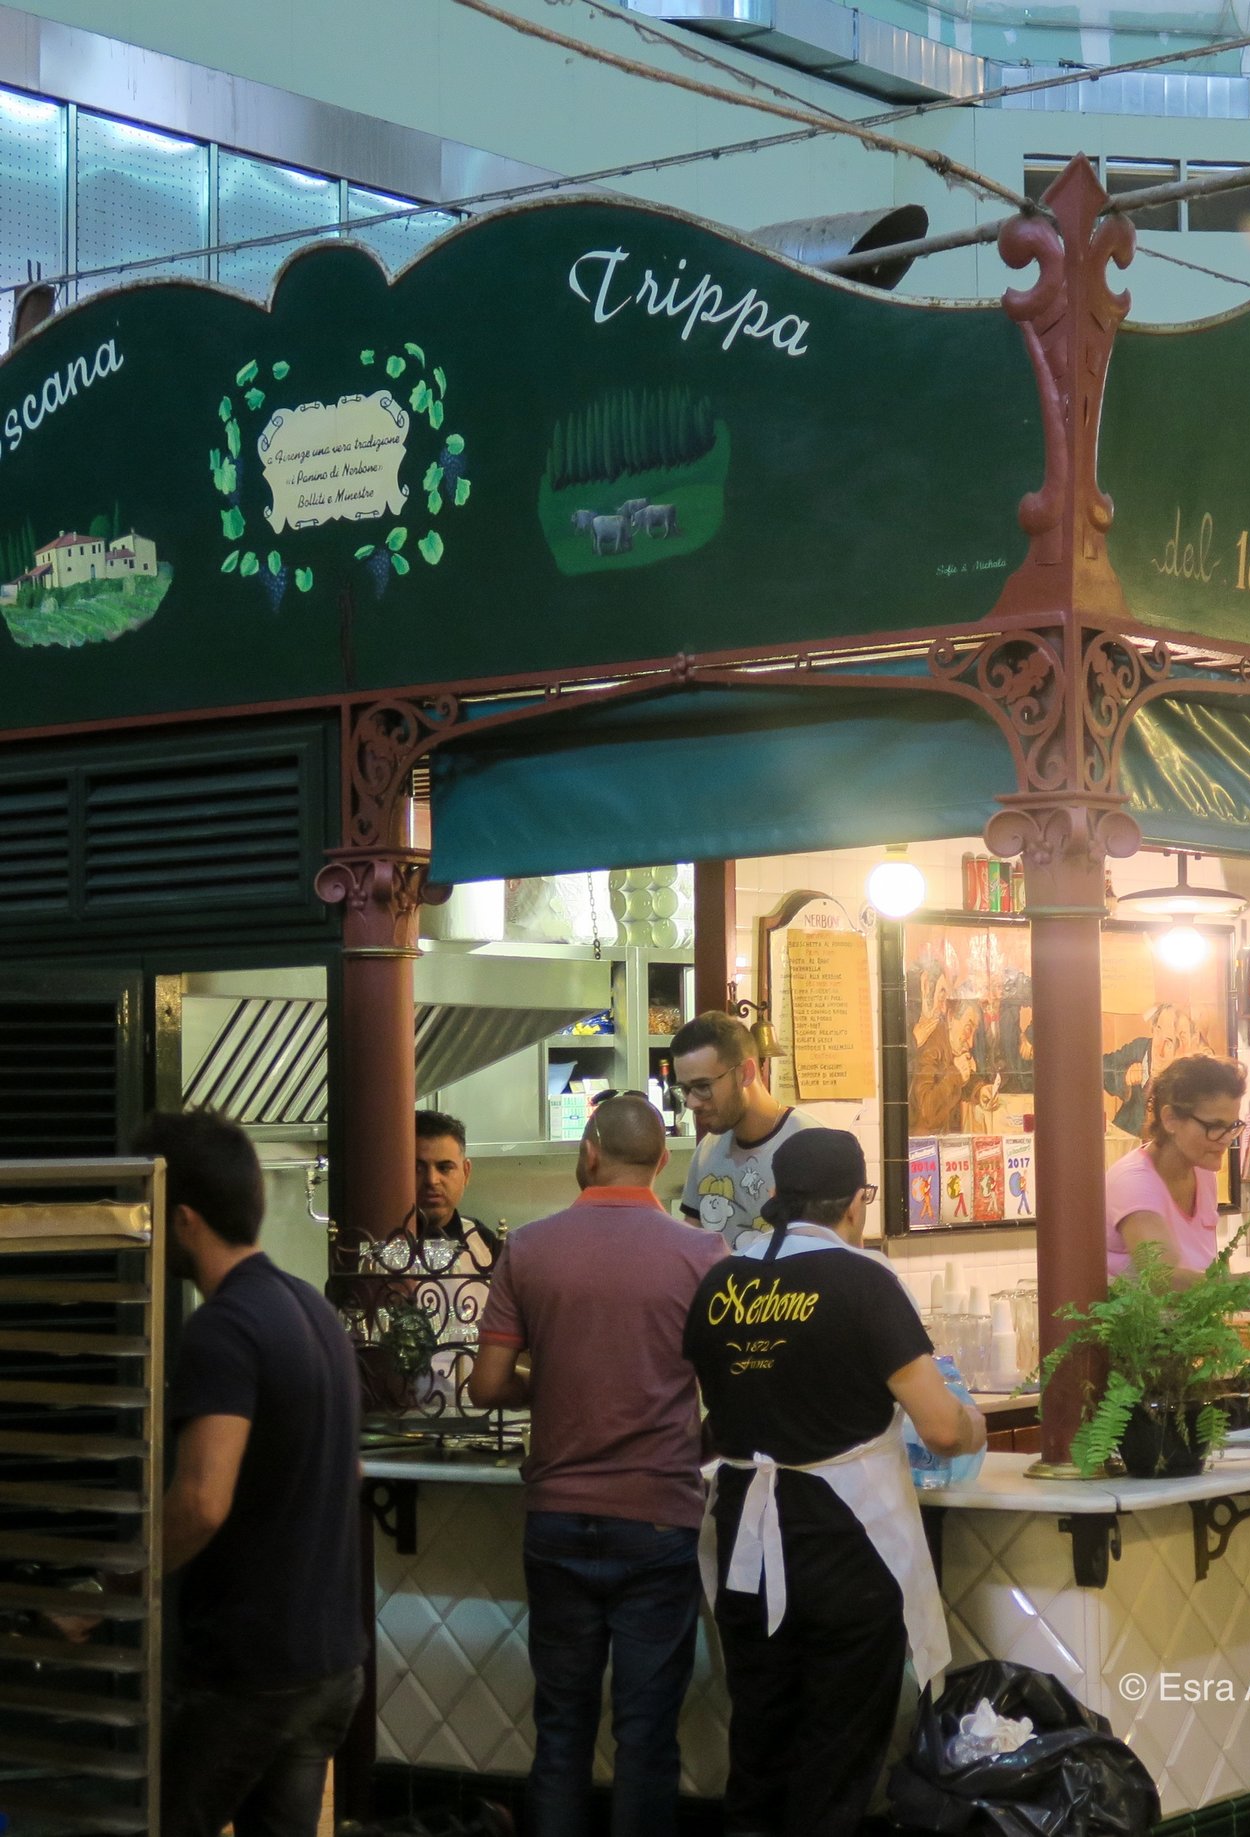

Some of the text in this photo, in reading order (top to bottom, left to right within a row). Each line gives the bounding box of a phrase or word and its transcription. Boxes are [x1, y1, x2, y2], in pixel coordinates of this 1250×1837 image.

[569, 246, 810, 356] Trippa
[0, 339, 124, 451] scana
[275, 450, 310, 465] Firenze
[312, 447, 330, 457] una
[331, 444, 352, 454] vera
[354, 434, 401, 453] tradizione
[296, 468, 328, 485] Panino
[330, 465, 339, 478] di
[298, 485, 375, 509] Bolliti e Minestre
[1151, 505, 1221, 584] del
[945, 1160, 969, 1172] 2015
[1007, 1157, 1030, 1169] 2017
[708, 1273, 820, 1326] Nerbone
[746, 1340, 770, 1353] 1872
